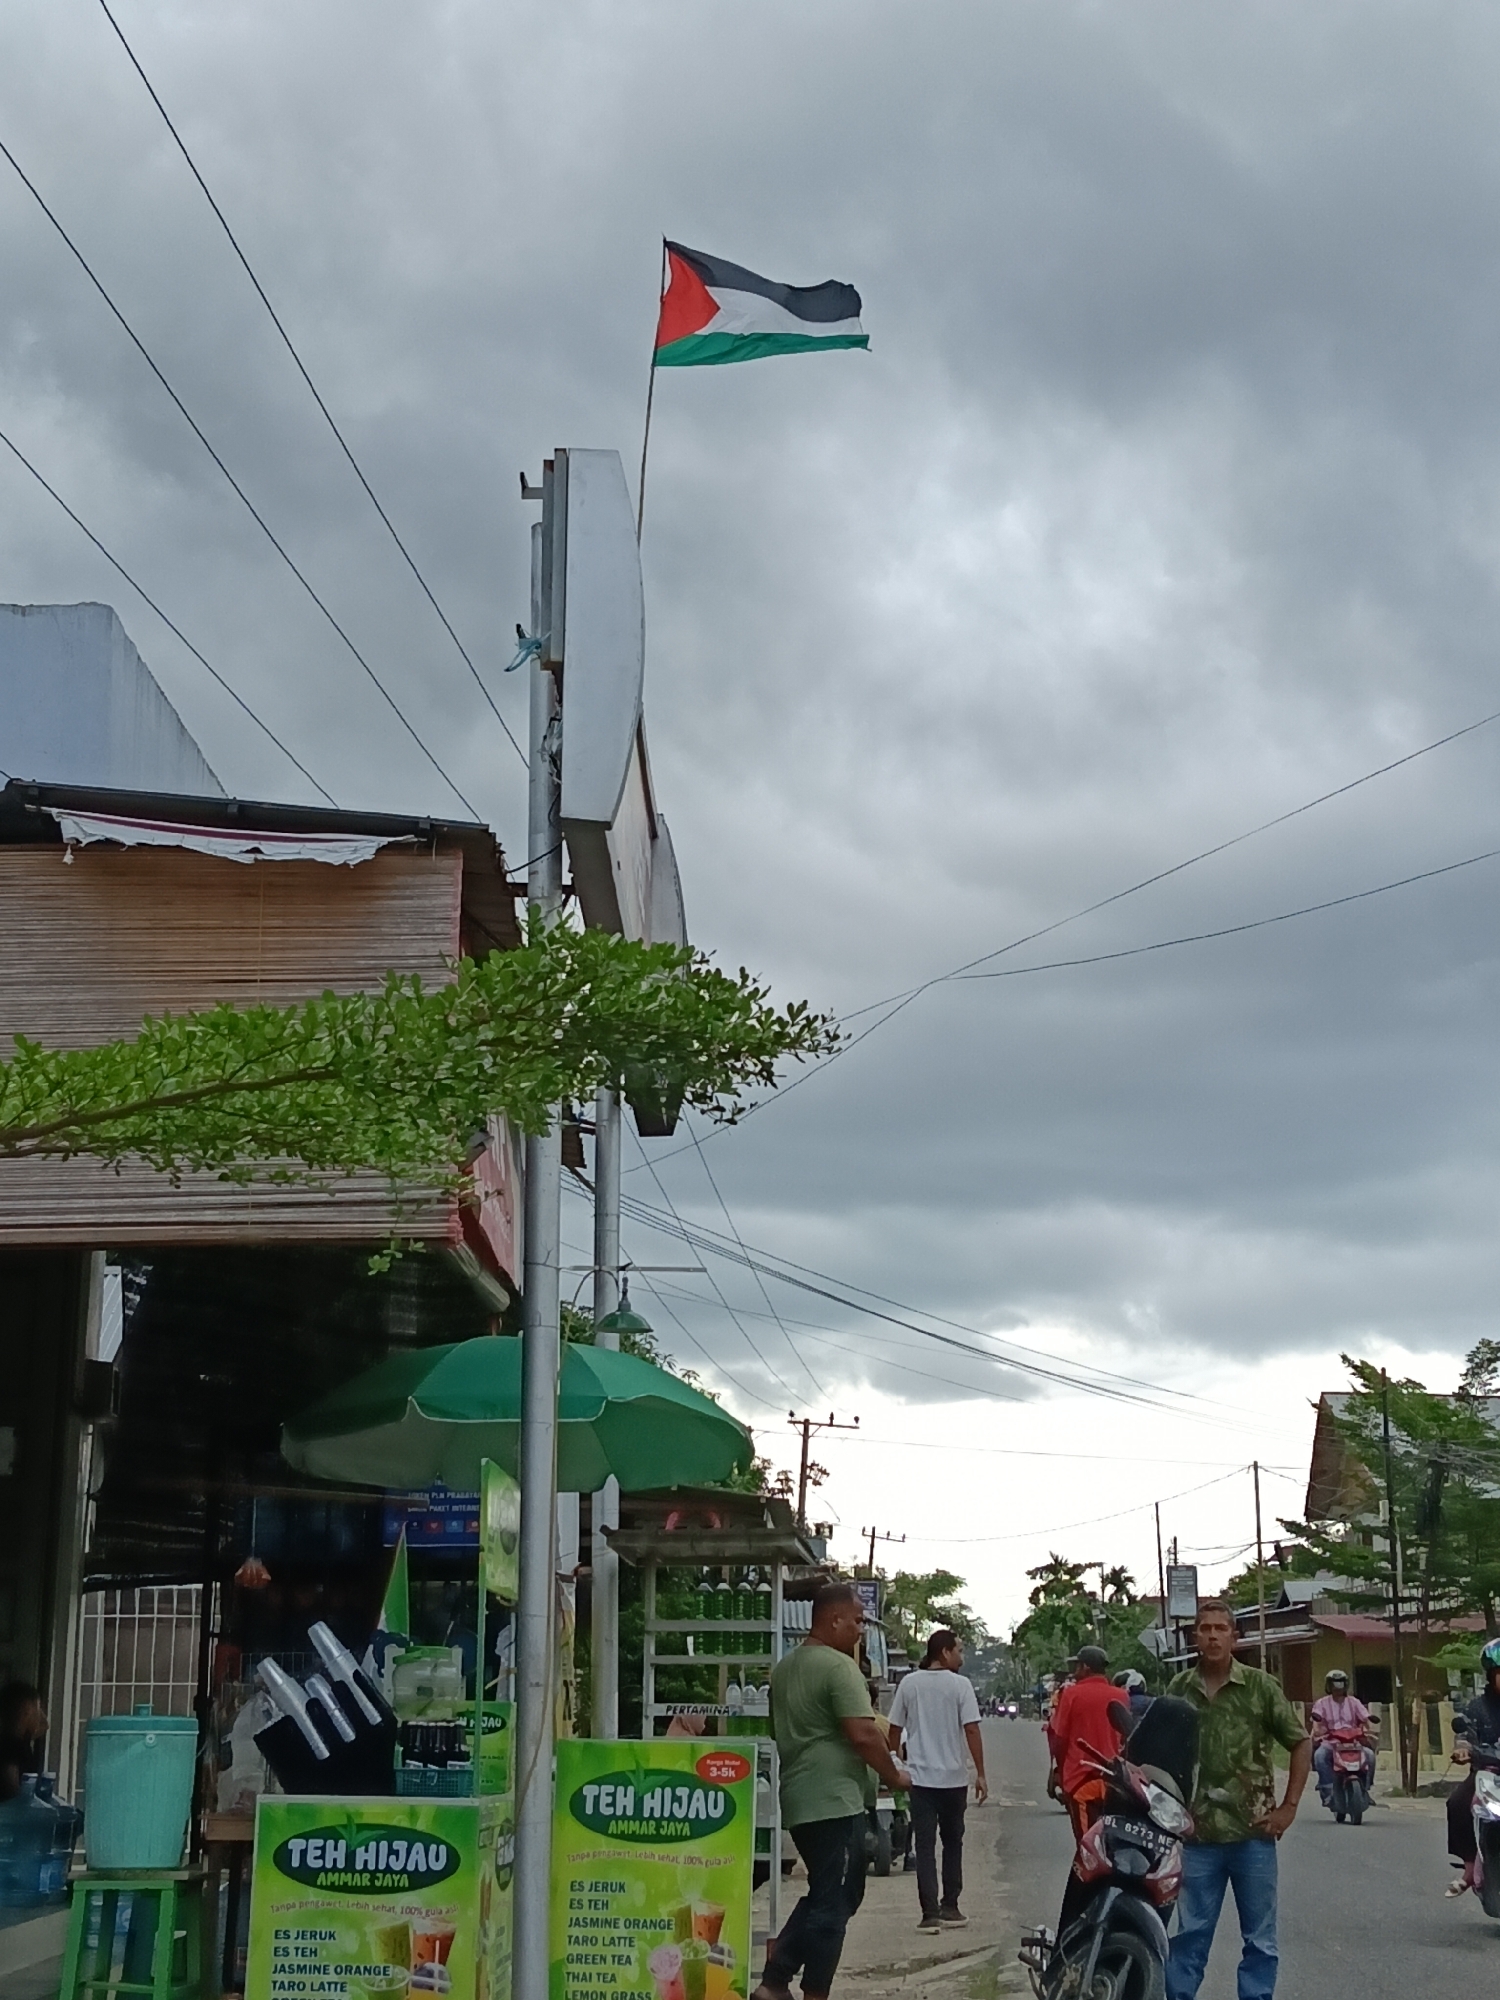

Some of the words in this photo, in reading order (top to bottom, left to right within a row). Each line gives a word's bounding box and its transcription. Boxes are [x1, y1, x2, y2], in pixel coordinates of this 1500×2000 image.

[665, 1705, 730, 1715] PERTAMINA
[469, 1716, 502, 1728] HJAU
[709, 1766, 736, 1778] 3-5k
[583, 1784, 635, 1816] TEH
[643, 1786, 725, 1820] HIJAU
[608, 1820, 656, 1835] AMMAR
[660, 1820, 691, 1836] JAYA
[1158, 1834, 1175, 1848] NE
[288, 1838, 346, 1868] TEH
[355, 1840, 447, 1872] HIJAU
[566, 1851, 590, 1863] Tanpa
[683, 1855, 704, 1866] 100%
[316, 1872, 370, 1886] AMMAR
[375, 1872, 409, 1887] JAYA
[570, 1880, 585, 1892] ES
[588, 1880, 626, 1893] JERUK
[270, 1901, 296, 1914] Tanpa
[346, 1900, 370, 1910] Lebih
[400, 1904, 423, 1916] 100%
[424, 1906, 443, 1917] gula
[569, 1898, 584, 1910] ES
[587, 1898, 609, 1911] TEH
[567, 1916, 621, 1929] JASMINE
[623, 1918, 674, 1931] ORANGE
[274, 1929, 291, 1940] ES
[294, 1929, 337, 1941] JERUK
[567, 1935, 599, 1947] TARO
[602, 1935, 636, 1948] LATTE
[273, 1946, 290, 1958] ES
[293, 1946, 318, 1958] TEH
[566, 1953, 607, 1965] GREEN
[611, 1954, 632, 1966] TEA
[272, 1963, 330, 1976] JASMINE
[333, 1964, 391, 1977] ORANGE
[565, 1971, 592, 1983] THAI
[596, 1972, 617, 1984] TEA
[271, 1980, 307, 1992] TARO
[310, 1981, 348, 1993] LATTE
[565, 1989, 607, 2000] LEMON
[611, 1990, 652, 2000] GRASS
